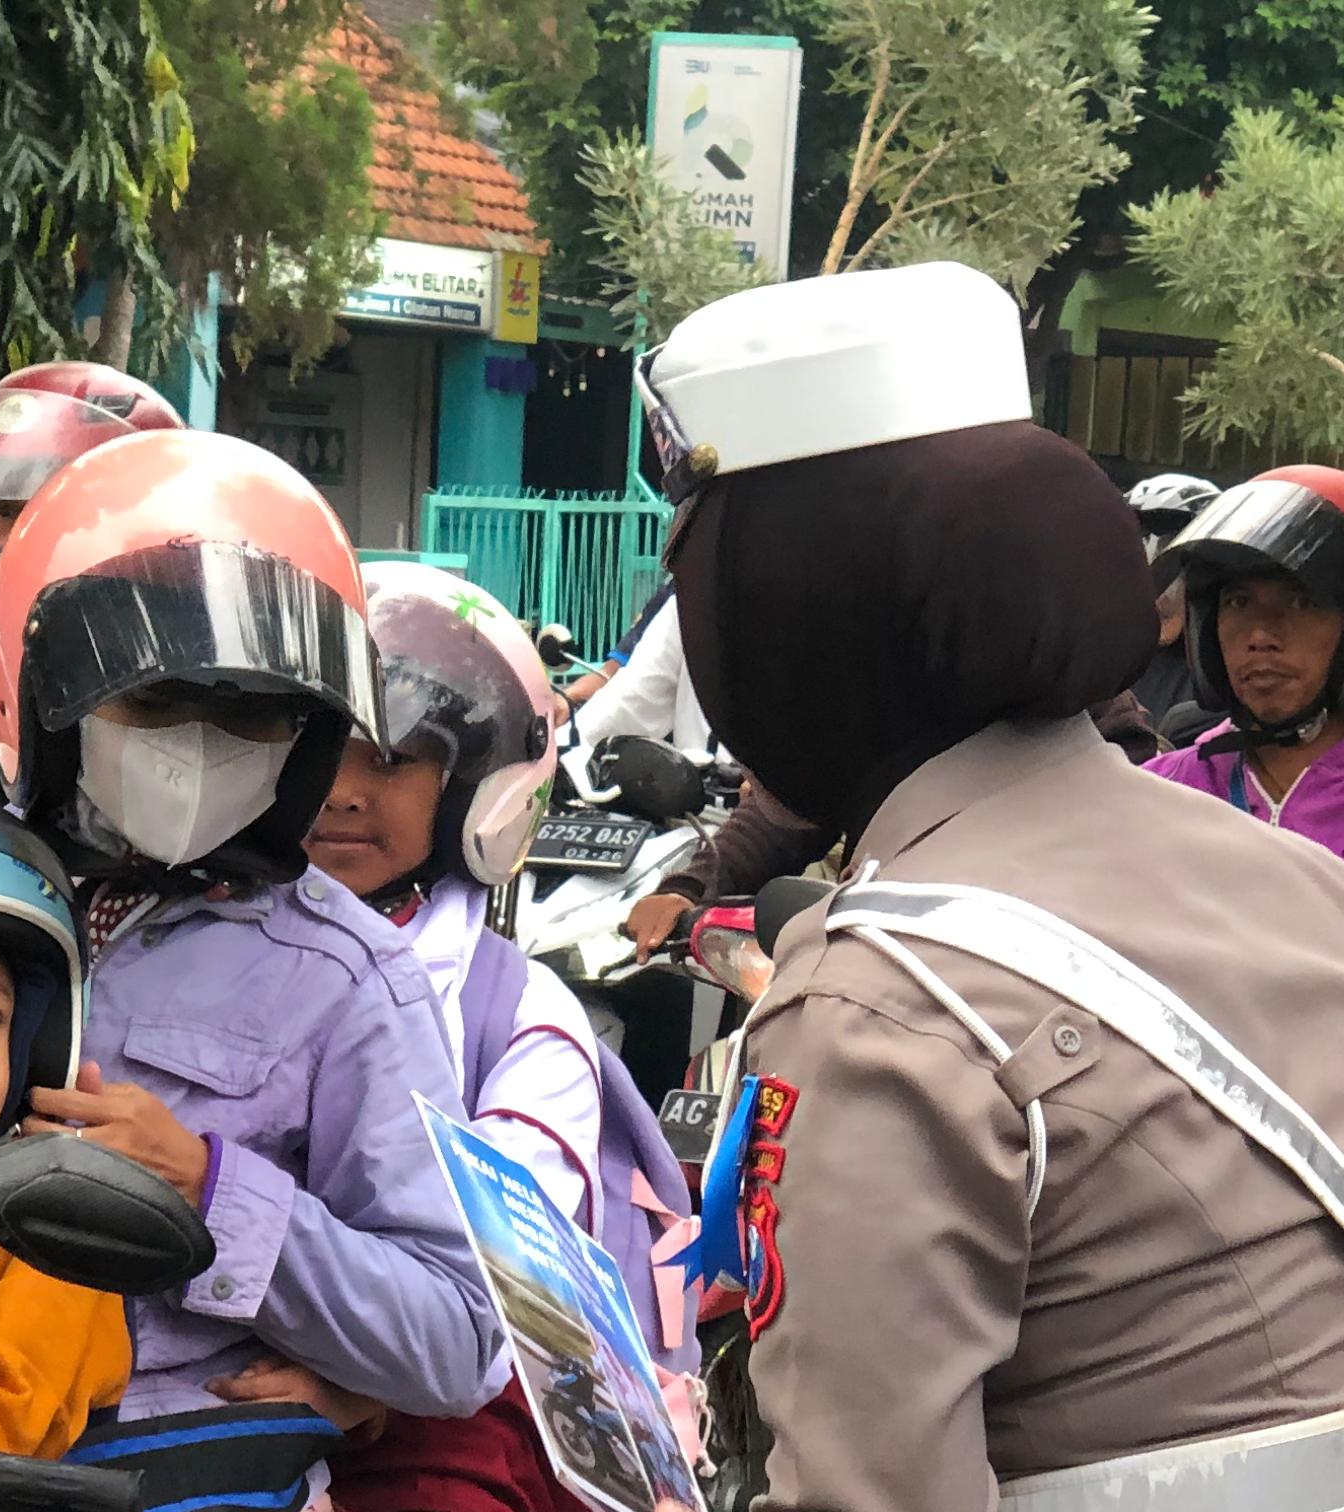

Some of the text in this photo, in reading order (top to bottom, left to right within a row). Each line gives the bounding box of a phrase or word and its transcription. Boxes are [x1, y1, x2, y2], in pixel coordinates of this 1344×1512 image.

[690, 192, 754, 208] UMAH
[536, 823, 593, 843] 6252
[664, 1096, 708, 1125] AG
